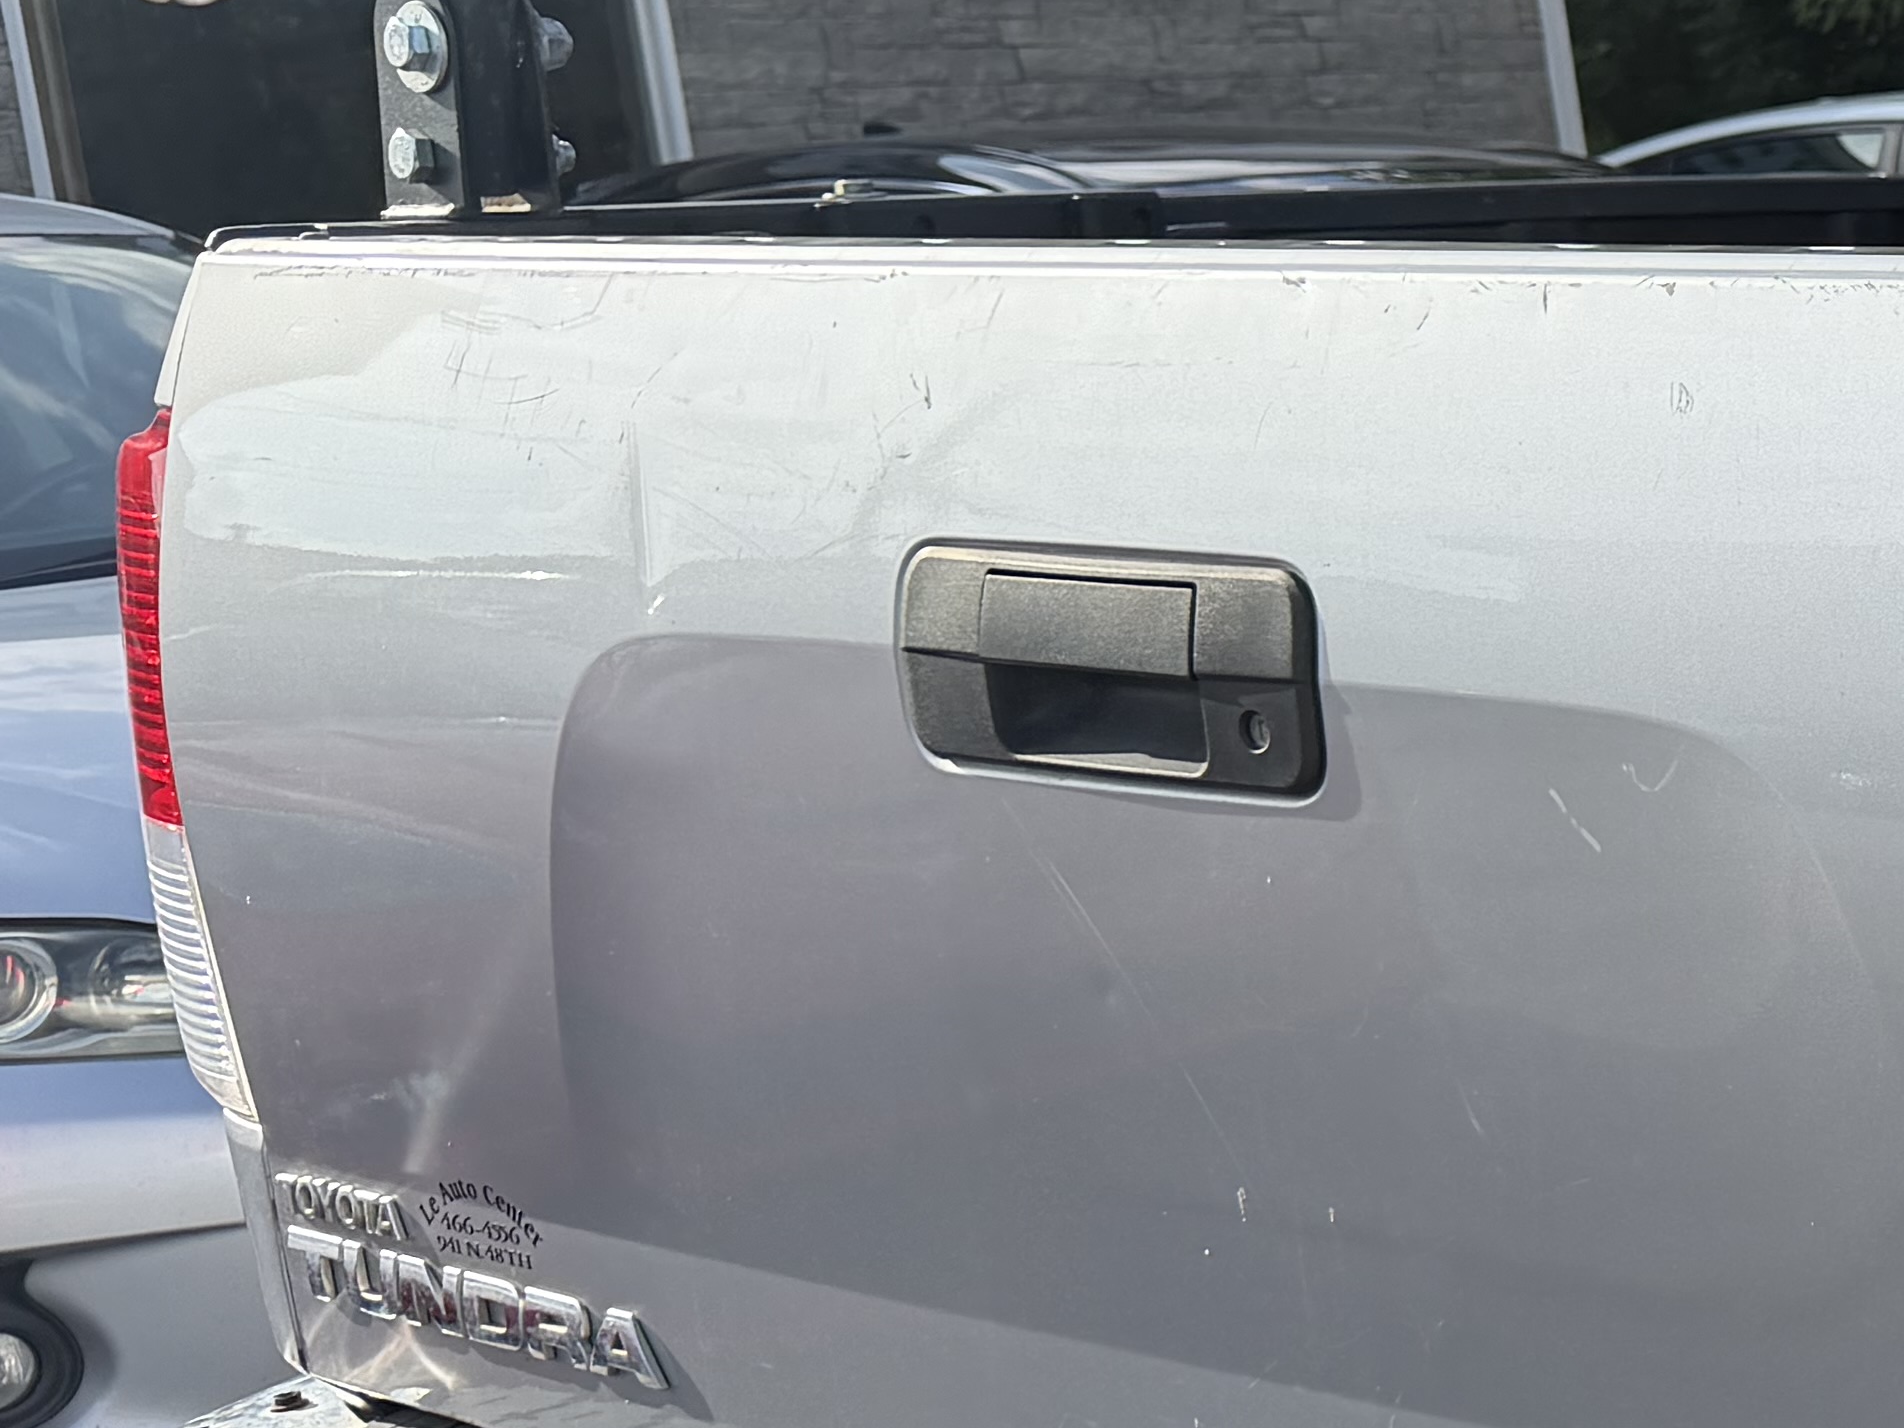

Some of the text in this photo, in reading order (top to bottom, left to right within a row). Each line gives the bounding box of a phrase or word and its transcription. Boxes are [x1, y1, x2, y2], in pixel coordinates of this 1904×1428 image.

[275, 1172, 410, 1241] TOYOTA
[419, 1179, 544, 1248] Le Auto Center
[440, 1212, 521, 1245] 466-4556
[436, 1235, 462, 1255] 941
[286, 1223, 672, 1391] TUNDRA
